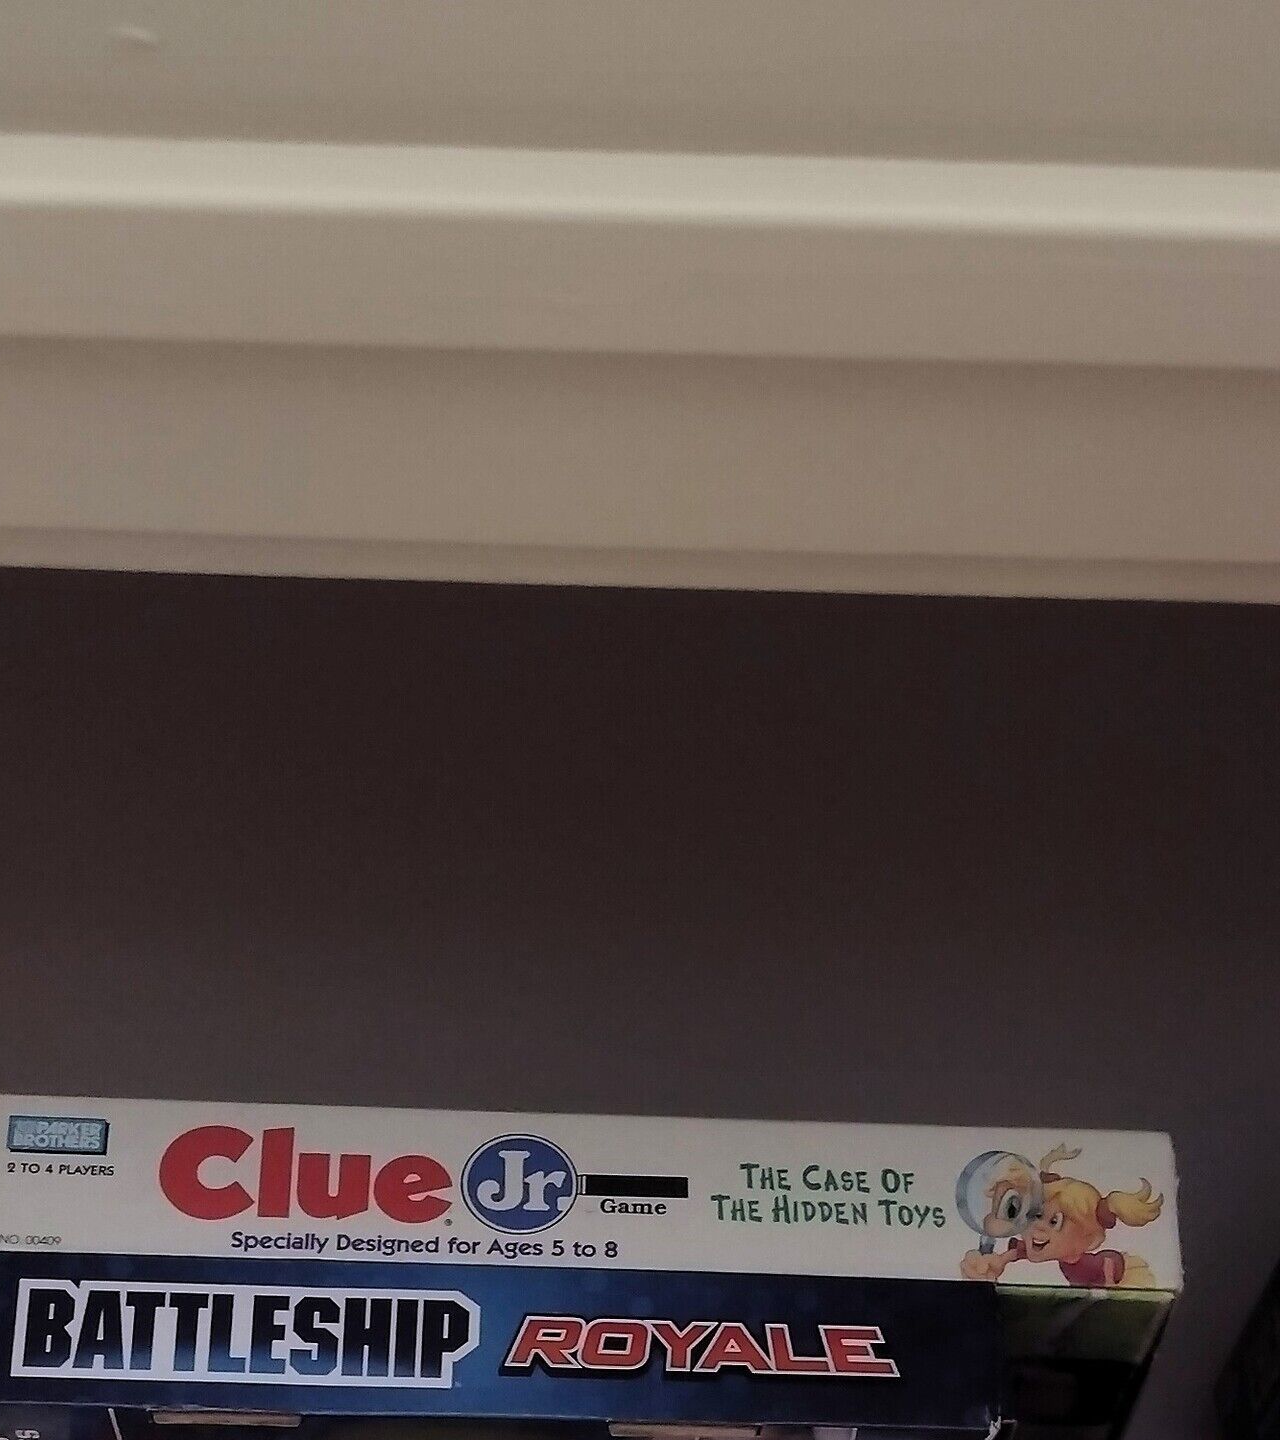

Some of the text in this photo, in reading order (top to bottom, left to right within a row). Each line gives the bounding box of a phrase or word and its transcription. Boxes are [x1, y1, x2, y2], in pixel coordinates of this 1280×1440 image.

[13, 1133, 101, 1150] BROTHERS
[8, 1162, 114, 1176] 2 TO 4 PLAYERS
[160, 1124, 455, 1224] Clue
[740, 1163, 916, 1195] THE CASE OF
[600, 1198, 668, 1216] Game
[711, 1195, 947, 1229] THE HIDDEN TOYS
[231, 1231, 619, 1259] Specially Designed for Ages 5 to 8
[18, 1284, 475, 1384] BATTLESHIP
[505, 1314, 900, 1377] ROYALE
